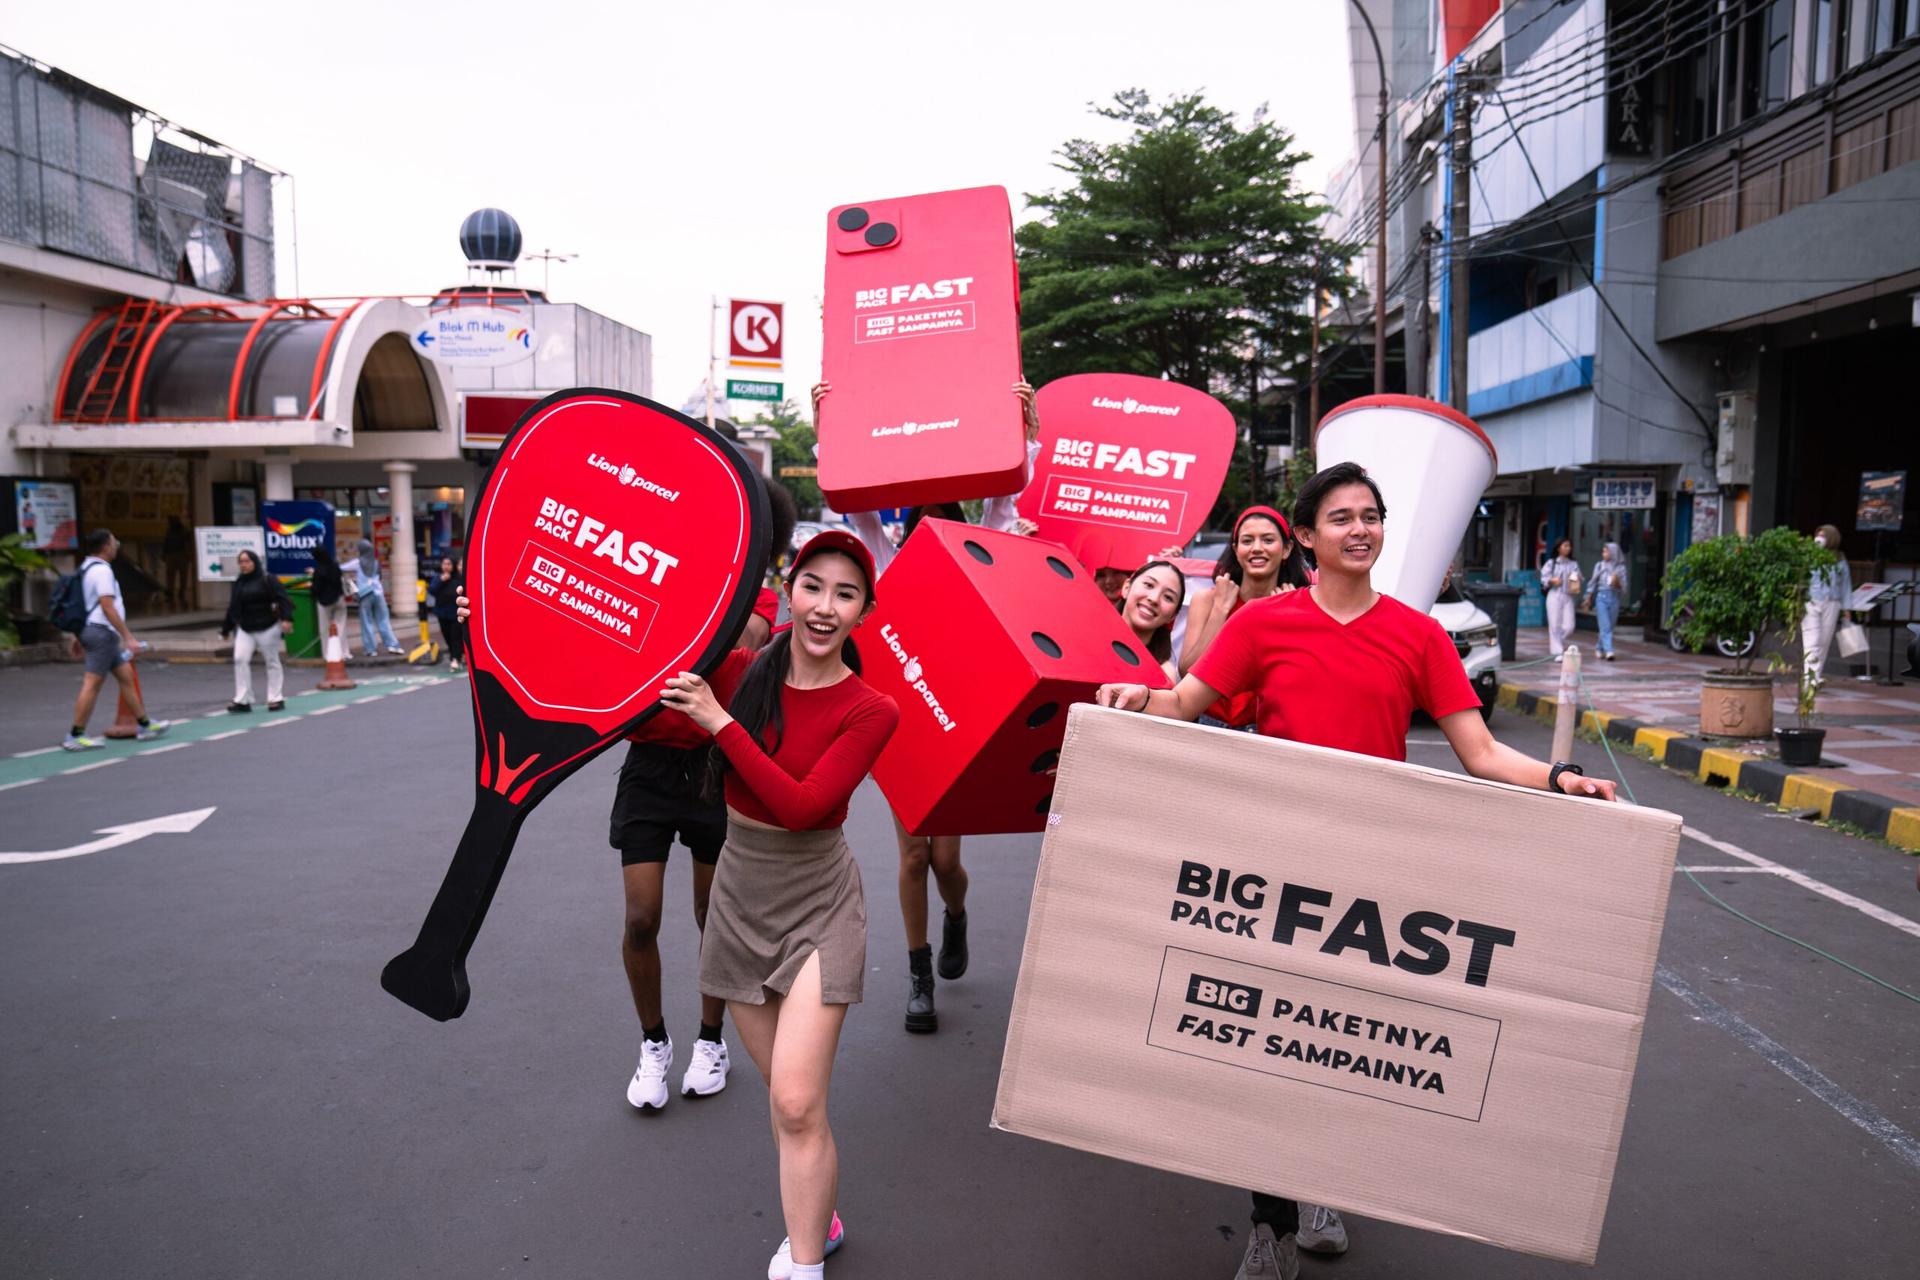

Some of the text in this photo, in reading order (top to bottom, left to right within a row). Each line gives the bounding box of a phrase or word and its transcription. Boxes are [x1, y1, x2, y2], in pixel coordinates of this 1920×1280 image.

[856, 288, 888, 302] BIG
[856, 298, 888, 309] PACK
[891, 277, 974, 304] FAST
[439, 321, 505, 332] Blok M Hub
[867, 319, 963, 337] FAST SAMPAINYA
[898, 309, 963, 323] PAKETNYA
[747, 316, 775, 350] K
[1092, 397, 1180, 416] Lion parcel
[871, 418, 960, 437] Lion parcel
[1055, 438, 1094, 457] BIG
[1052, 454, 1090, 469] PACK
[1093, 443, 1196, 480] FAST
[586, 453, 680, 502] Lion parcel
[539, 497, 580, 528] BIG
[1054, 500, 1167, 525] FAST SAMPAINYA
[1094, 490, 1171, 510] PAKETNYA
[1597, 497, 1648, 507] SPORT
[266, 532, 317, 549] Dulux
[534, 516, 573, 542] PACK
[573, 515, 679, 586] FAST
[536, 559, 639, 619] BIG PAKETNYA
[525, 575, 632, 636] FAST SAMPAINYA
[880, 623, 957, 732] Lion parcel
[1176, 860, 1268, 910] BIG
[1170, 900, 1260, 940] PACK
[1272, 882, 1516, 988] FAST
[1194, 978, 1453, 1058] BIG PAKETNYA
[1176, 1014, 1445, 1094] FAST SAMPAINYA
